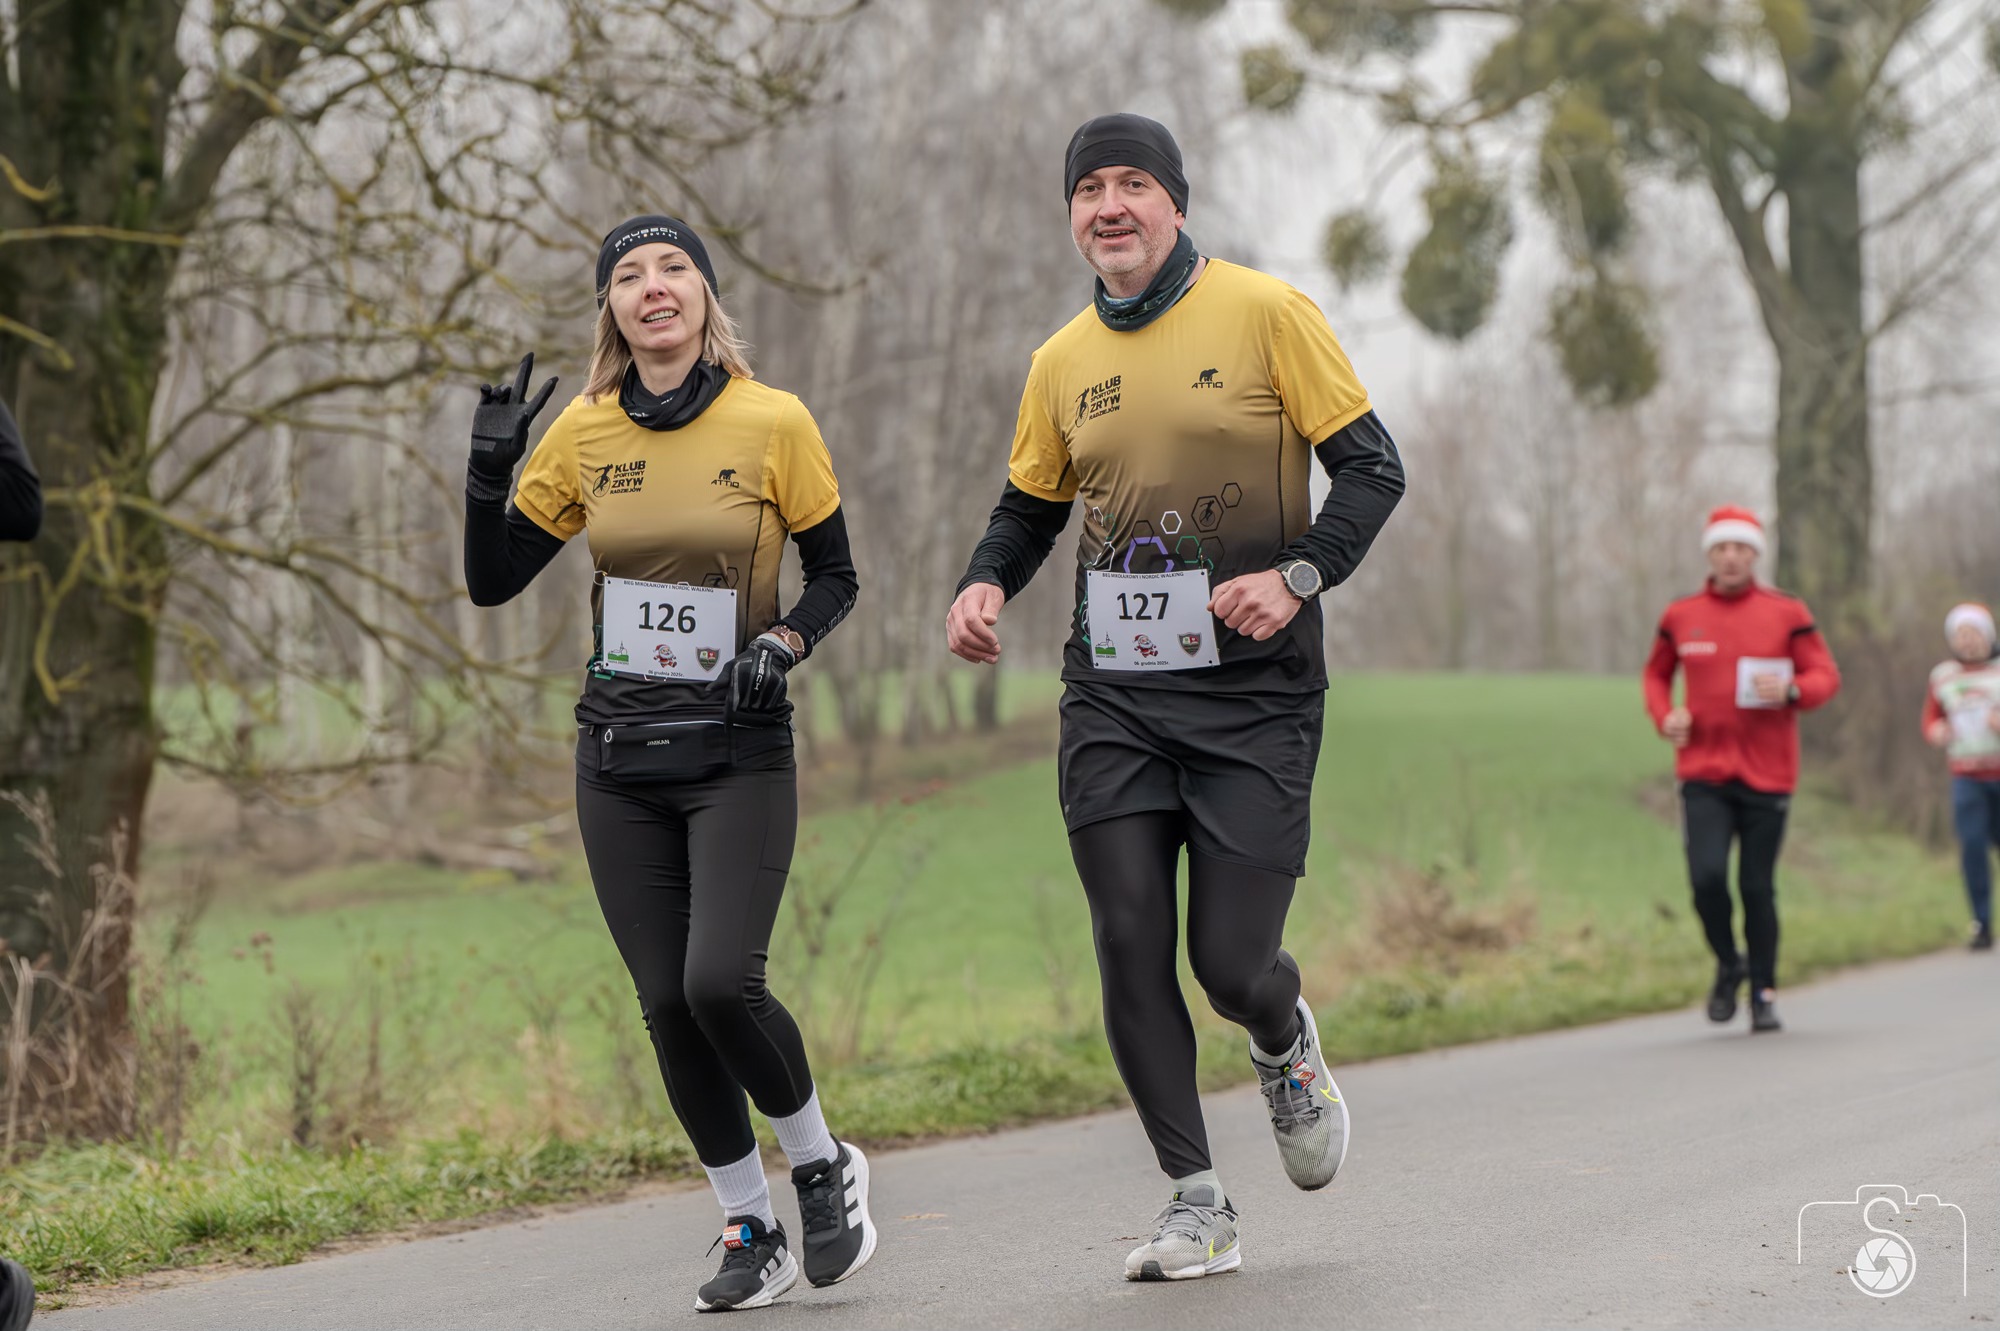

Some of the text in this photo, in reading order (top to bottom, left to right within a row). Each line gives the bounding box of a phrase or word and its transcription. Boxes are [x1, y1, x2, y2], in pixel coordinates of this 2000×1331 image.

[1090, 386, 1121, 402] SPORTOWY
[1091, 375, 1121, 397] KLUB
[1090, 393, 1121, 413] ZRYW
[613, 470, 645, 479] SPORTOWY
[614, 460, 646, 473] KLUB
[612, 476, 644, 489] ZRYW
[1116, 592, 1169, 620] 127
[638, 601, 697, 634] 126
